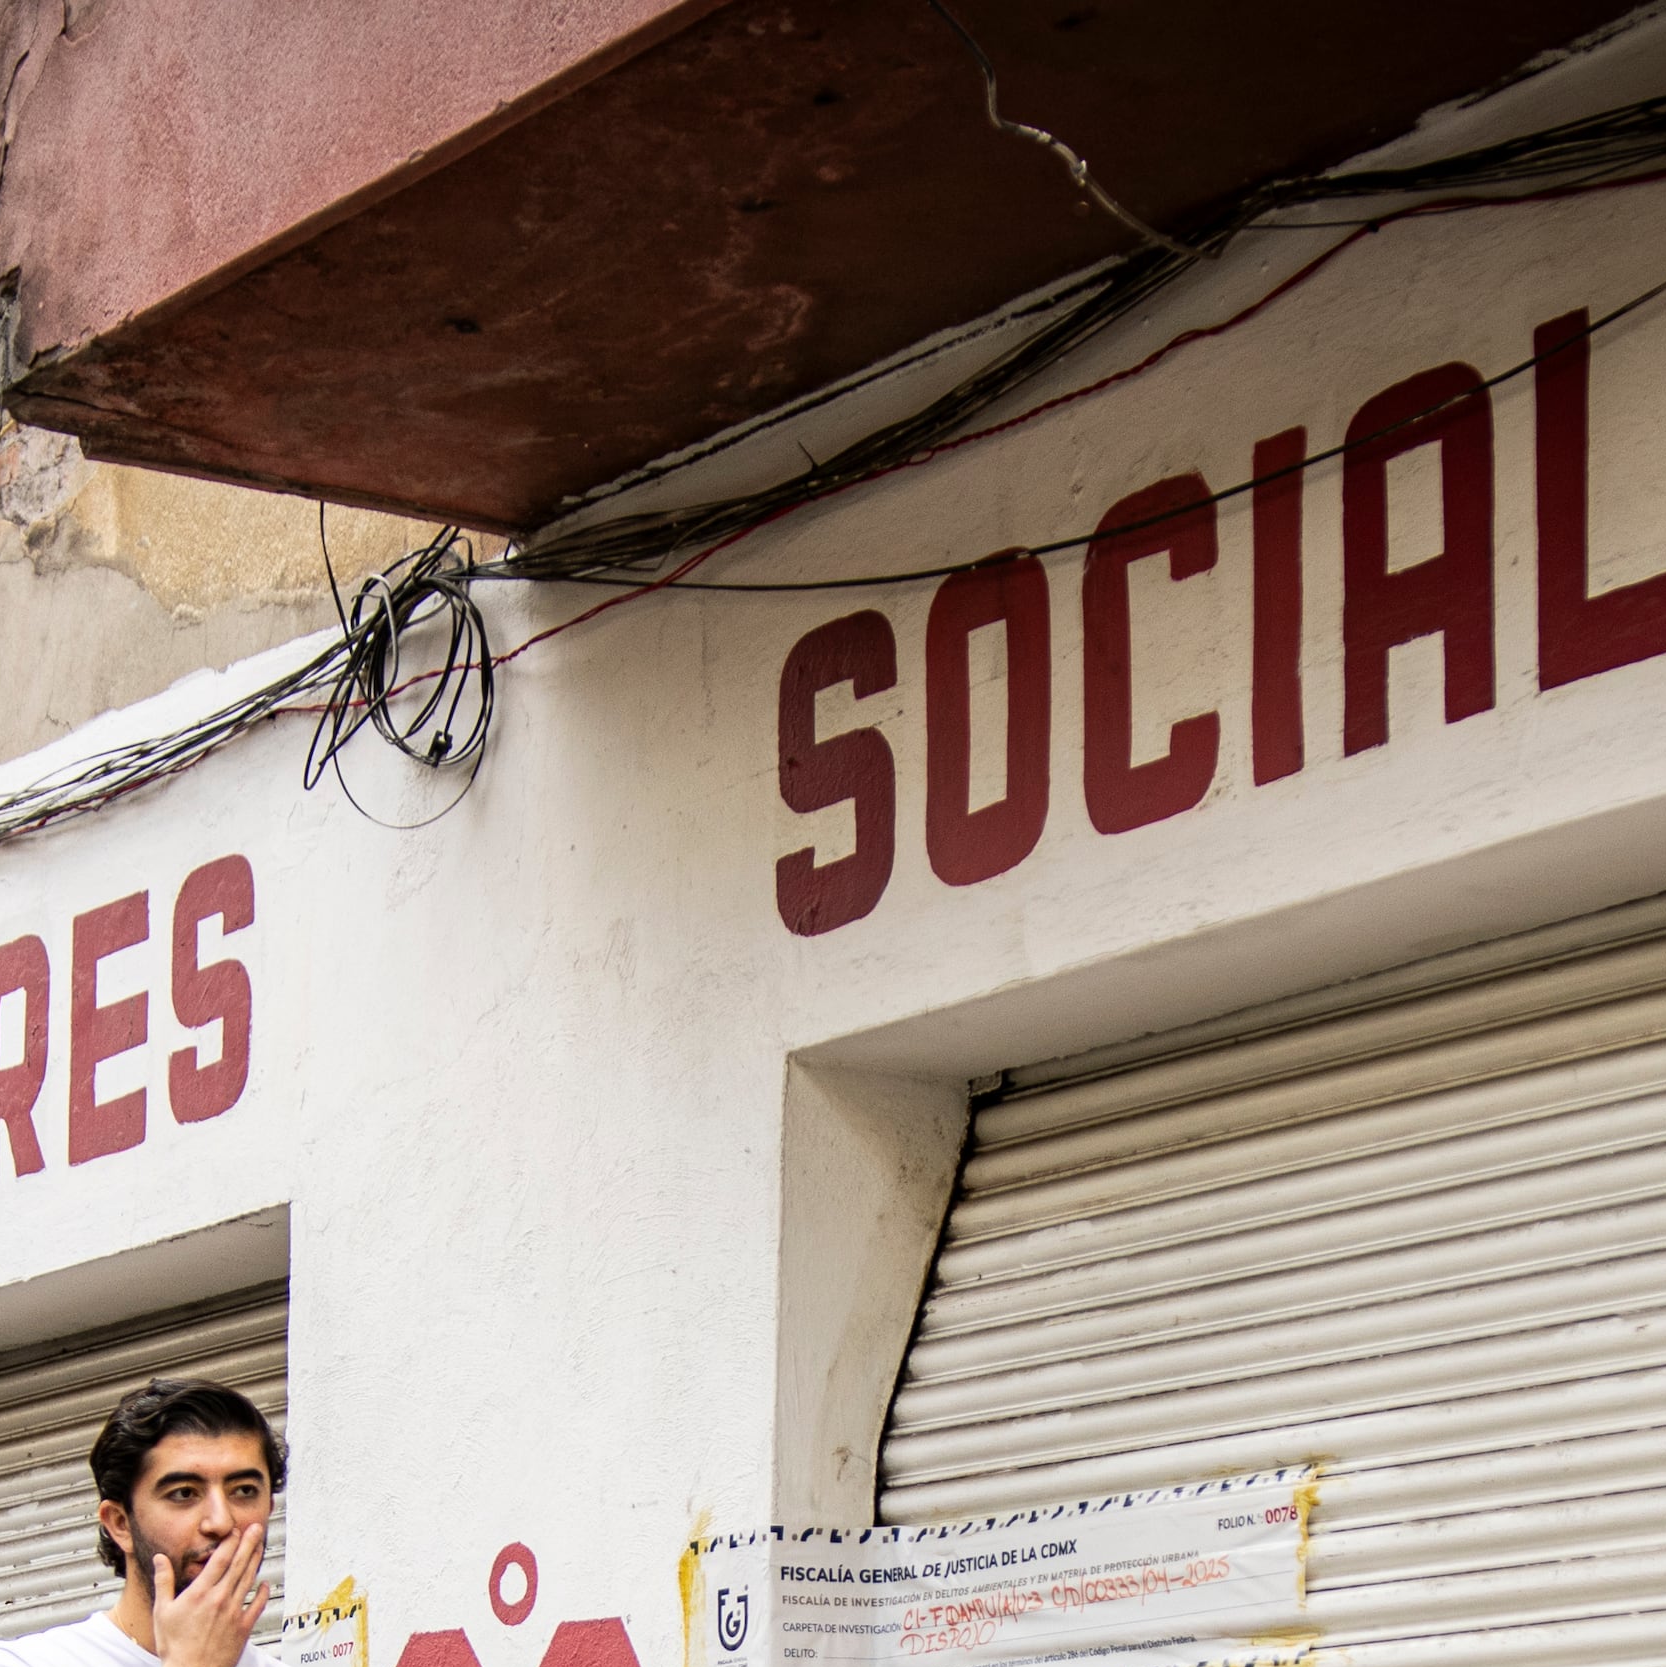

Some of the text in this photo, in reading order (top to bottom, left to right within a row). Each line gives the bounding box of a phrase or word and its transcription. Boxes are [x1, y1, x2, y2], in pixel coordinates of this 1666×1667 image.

[1218, 1515, 1246, 1530] FOLIO
[1265, 1504, 1299, 1524] 0078
[781, 1539, 1078, 1584] FISCALÍA GENERAL DE JUSTICIA DE LA CDMX
[782, 1593, 831, 1606] FISCALÍA
[834, 1597, 847, 1607] DE
[851, 1592, 921, 1608] INVESTIGACIÓN
[923, 1591, 933, 1601] EN
[935, 1587, 969, 1599] DELITOS
[971, 1577, 1029, 1594] AMBIENTALES
[1037, 1574, 1049, 1584] EN
[1051, 1567, 1087, 1582] MATERIA
[1090, 1564, 1102, 1575] DE
[1104, 1555, 1159, 1573] PROTECCIÓN
[1162, 1550, 1200, 1563] URBANA
[783, 1621, 825, 1633] CARPETA
[825, 1623, 837, 1633] DE
[300, 1650, 320, 1664] FOLIO
[333, 1641, 354, 1658] 0077
[783, 1648, 819, 1659] DELITO:
